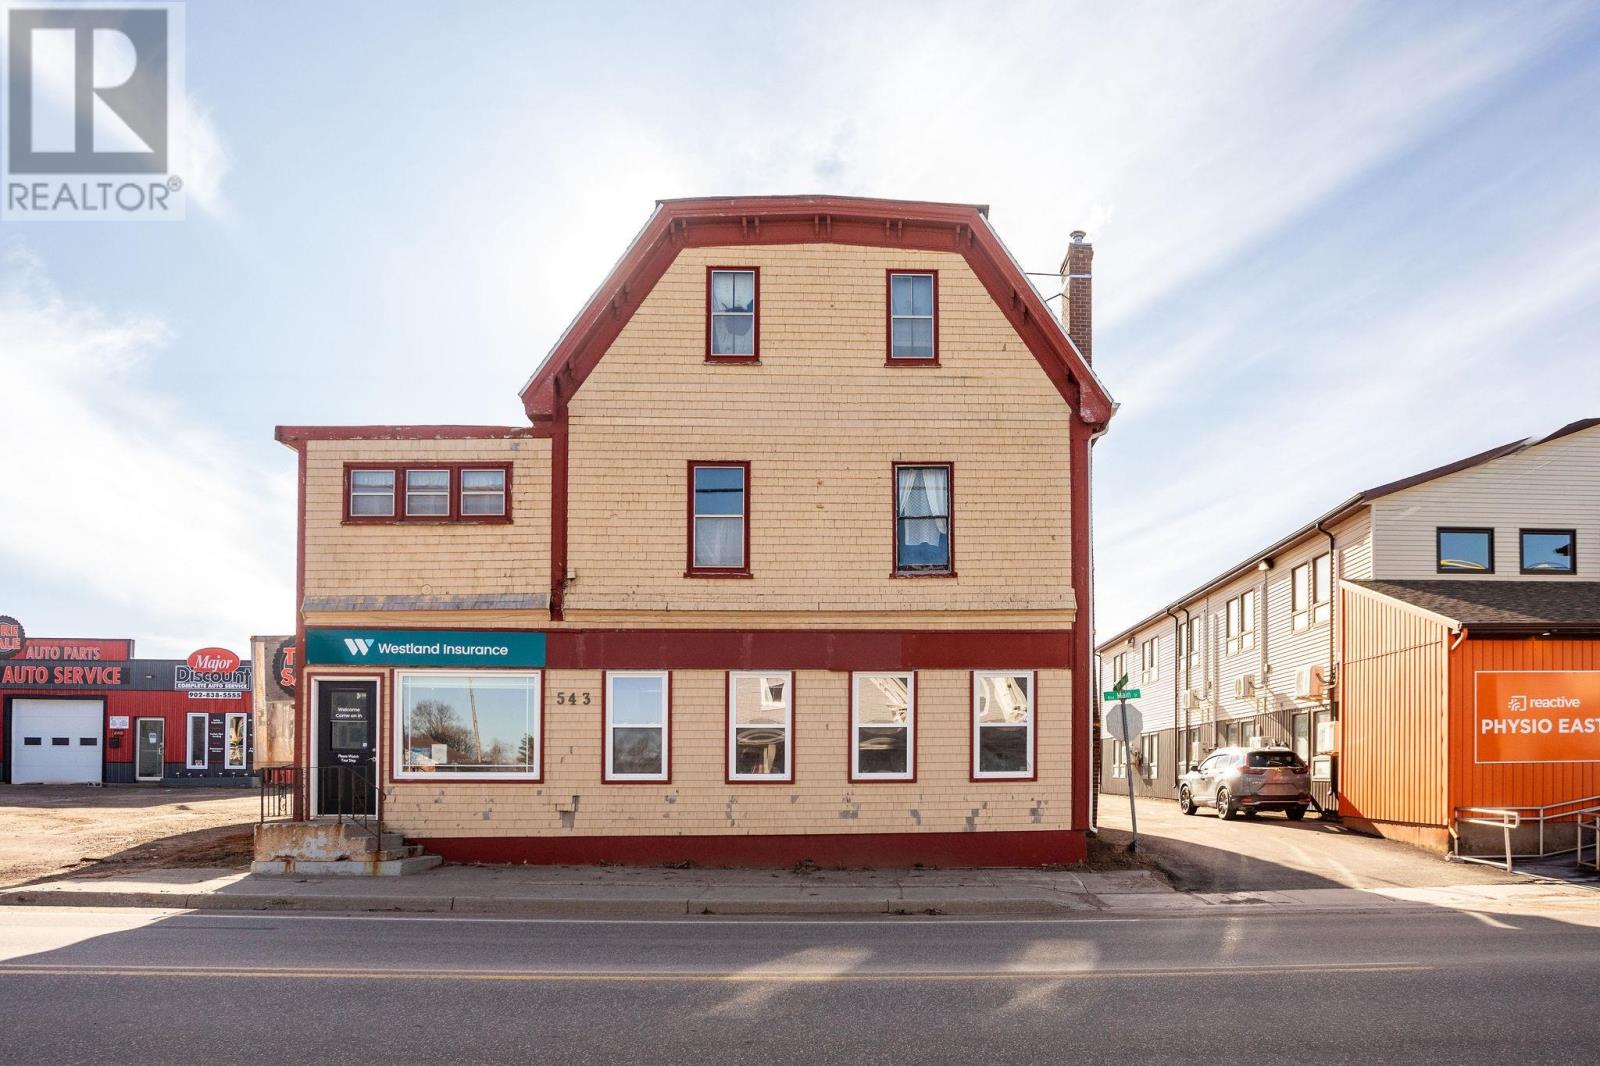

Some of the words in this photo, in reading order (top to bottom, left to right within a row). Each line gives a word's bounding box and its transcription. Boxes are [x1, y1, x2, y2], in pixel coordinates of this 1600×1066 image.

[0, 624, 19, 637] RE
[26, 646, 60, 660] AUTO
[63, 646, 101, 660] PARTS
[378, 643, 440, 655] Westland
[443, 643, 509, 656] Insurance
[194, 654, 233, 671] Major
[3, 665, 49, 684] AUTO
[54, 666, 121, 684] SERVICE
[176, 666, 252, 683] Discount
[556, 692, 591, 706] 543
[1530, 696, 1581, 708] reactive
[1481, 719, 1553, 734] PHYSIO
